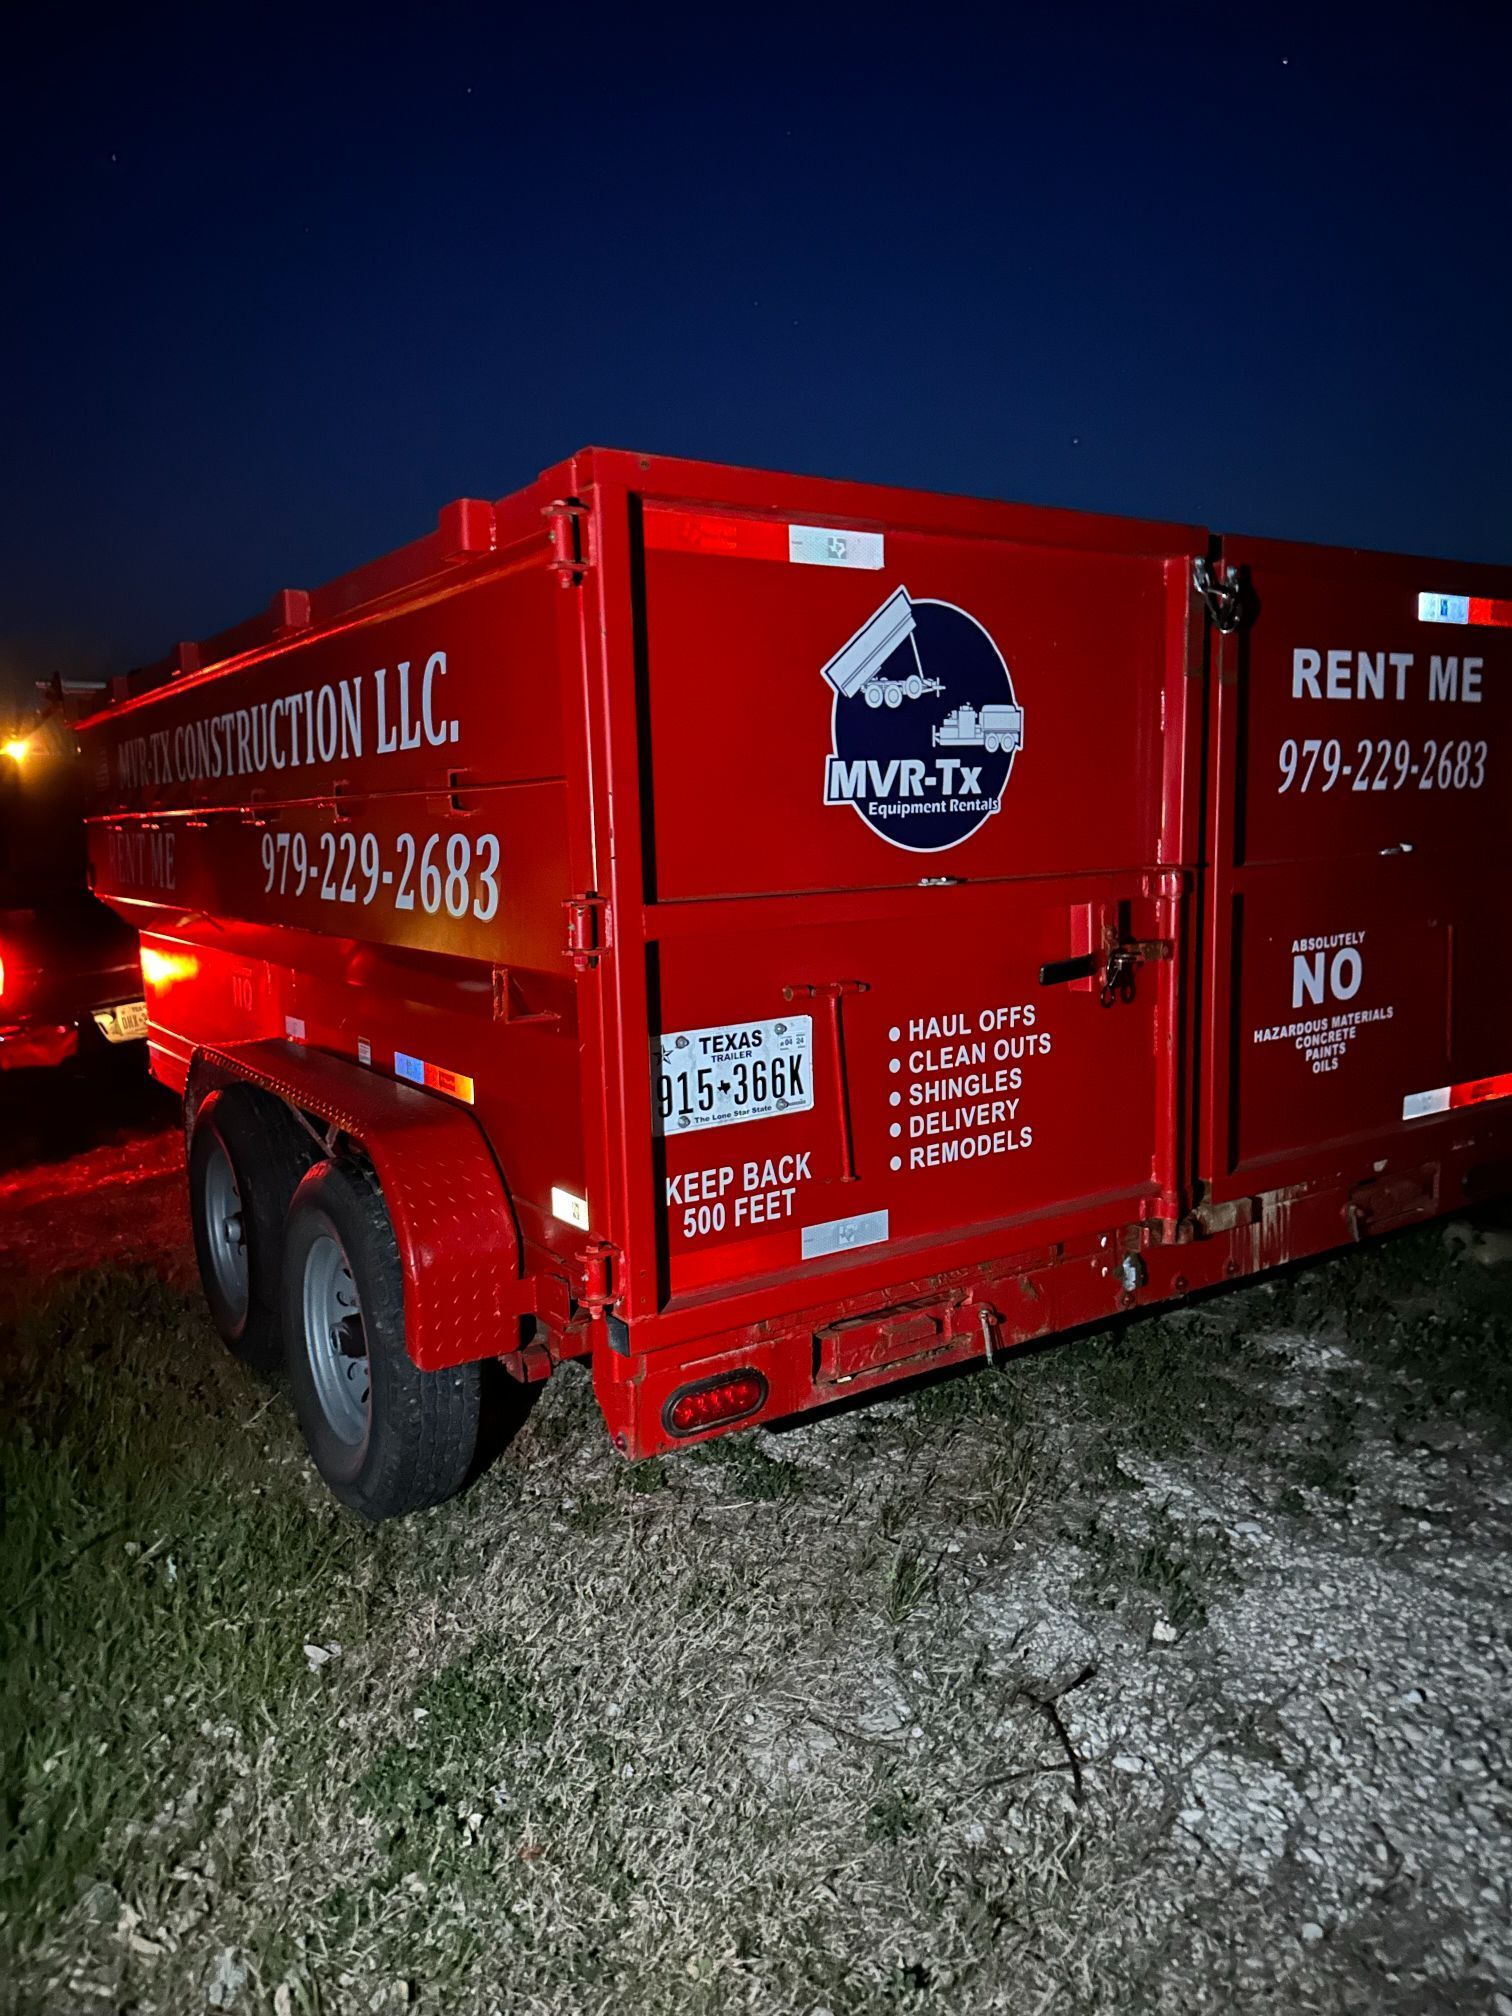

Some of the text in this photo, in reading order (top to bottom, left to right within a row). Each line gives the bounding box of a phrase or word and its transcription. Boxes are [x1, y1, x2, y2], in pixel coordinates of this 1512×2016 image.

[1291, 647, 1484, 703] RENT ME
[118, 729, 173, 791] MVR-TX
[175, 676, 363, 783] CONSTRUCTION
[374, 651, 459, 755] LLC.
[829, 758, 983, 799] MVR-Tx
[1277, 738, 1488, 794] 979-229-2683
[868, 797, 999, 819] Equipment Rentals
[108, 832, 176, 891] RENT ME
[261, 832, 500, 922] 979-229-2683
[1291, 931, 1366, 952] ABSOLUTELY
[1291, 946, 1363, 1009] NO
[699, 1029, 763, 1054] TEXAS
[909, 1004, 1036, 1042] HAUL OFFS
[1253, 1006, 1394, 1043] HAZARDOUS MATERIALS
[1295, 1026, 1357, 1049] CONCRETE
[711, 1050, 752, 1063] TRAILER
[908, 1032, 1052, 1074] CLEAN OUTS
[1304, 1042, 1347, 1062] PAINTS
[1311, 1057, 1339, 1074] OILS
[909, 1067, 1022, 1107] SHINGLES
[694, 1104, 773, 1124] The Lone Star State
[909, 1098, 1020, 1138] DELIVERY
[909, 1126, 1033, 1170] REMODELS
[665, 1151, 812, 1207] KEEP BACK
[683, 1187, 796, 1238] 500 FEET
